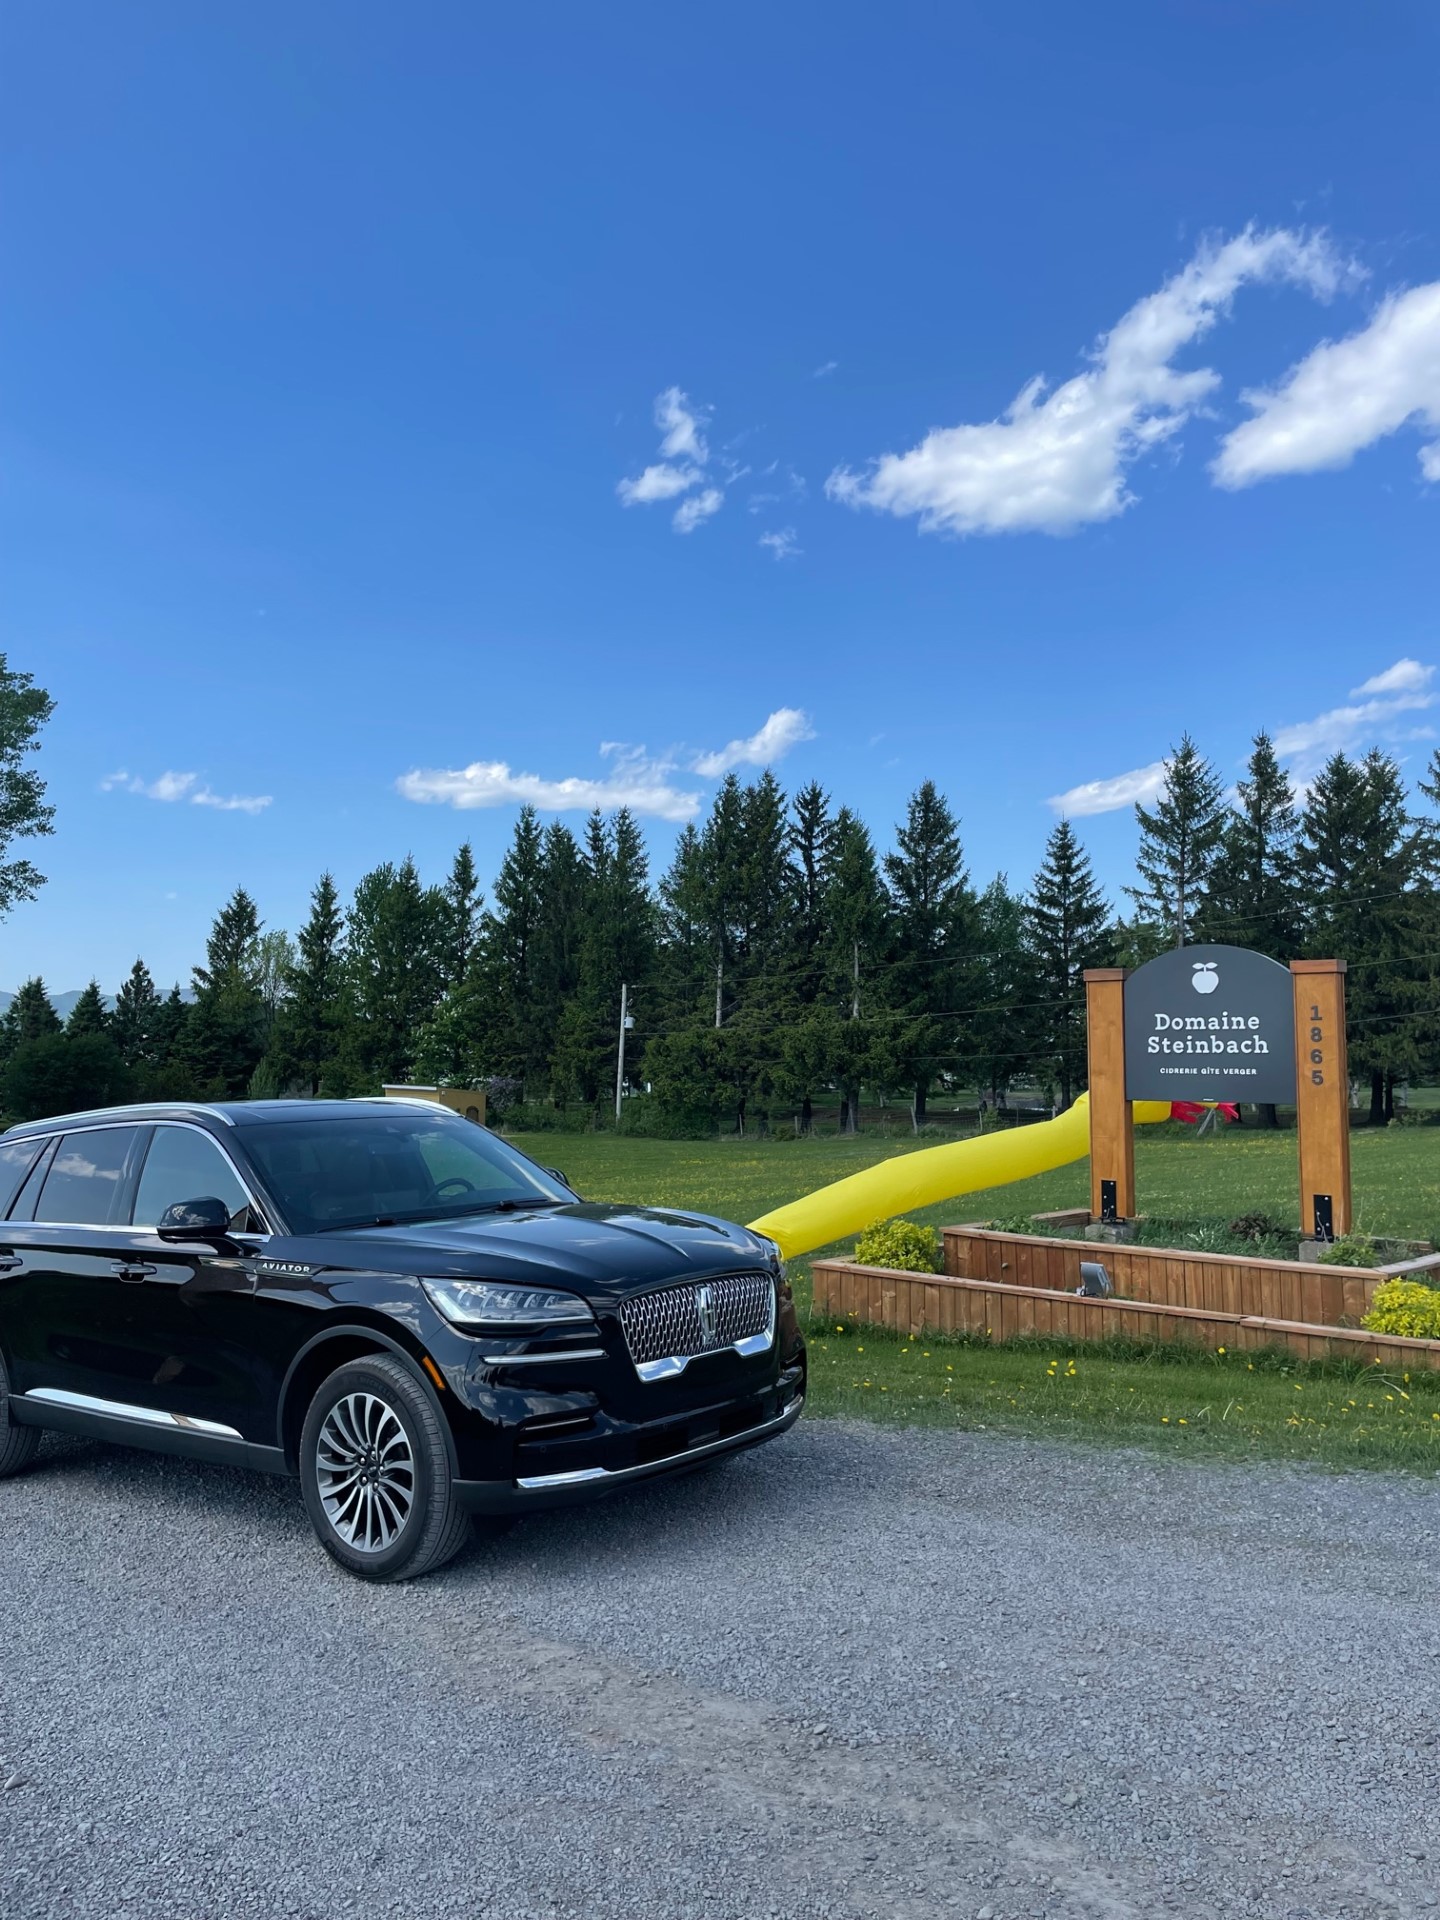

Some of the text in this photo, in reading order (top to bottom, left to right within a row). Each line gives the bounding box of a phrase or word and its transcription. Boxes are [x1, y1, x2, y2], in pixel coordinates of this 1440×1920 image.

[1154, 1011, 1260, 1030] Domaine
[1147, 1035, 1269, 1054] Steinbach
[1310, 1005, 1324, 1086] 1865
[1160, 1067, 1198, 1075] CIDRERIE
[1201, 1066, 1220, 1075] GÎTE
[262, 1262, 311, 1273] AVIATOR
